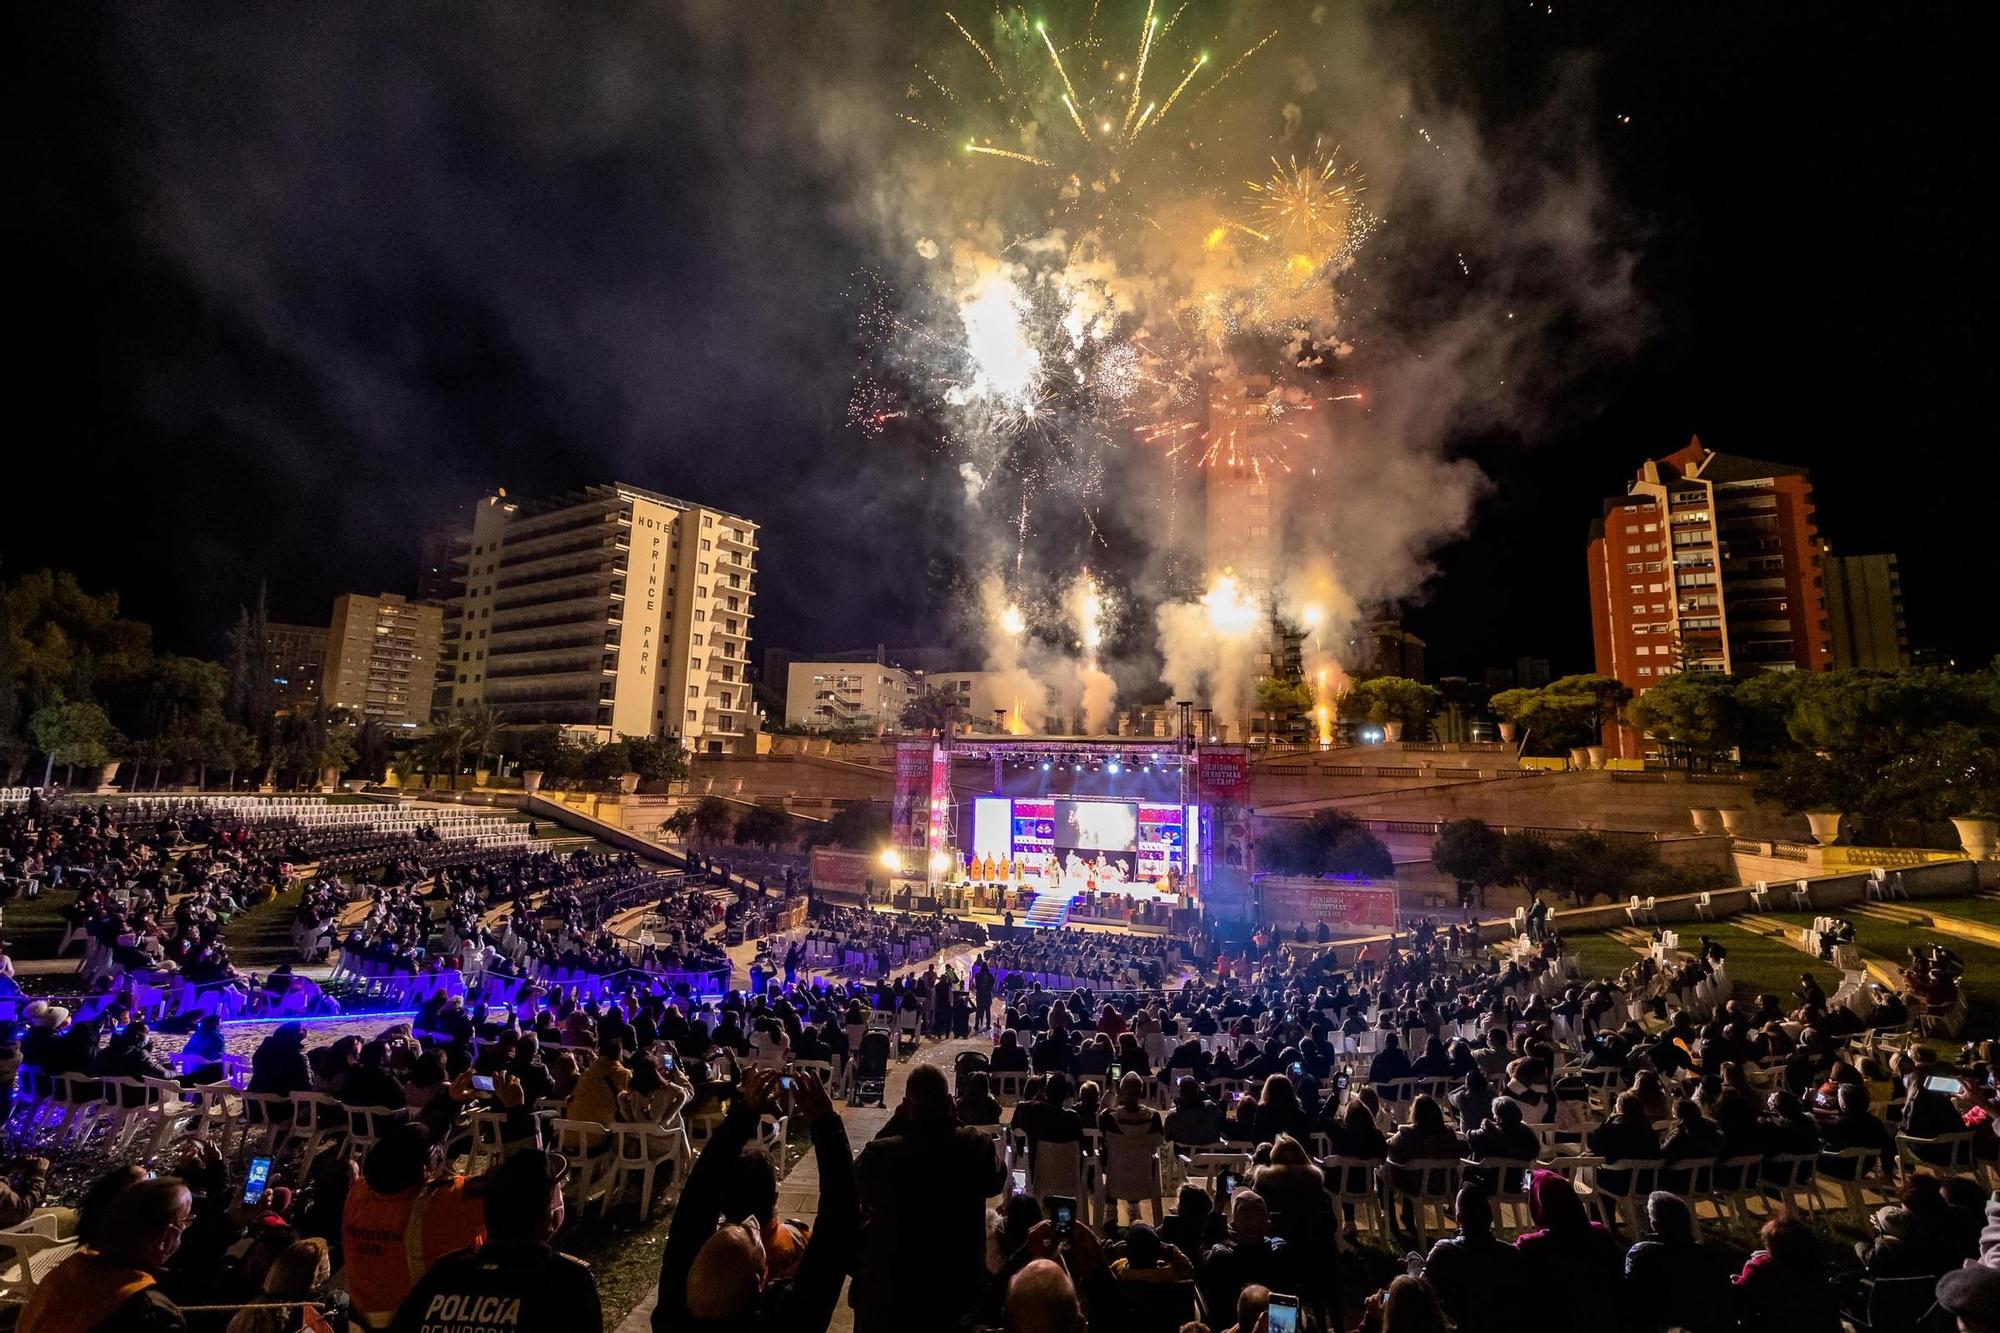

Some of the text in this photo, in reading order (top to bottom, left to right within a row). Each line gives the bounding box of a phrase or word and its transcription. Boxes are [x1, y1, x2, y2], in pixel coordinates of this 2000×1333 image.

[638, 516, 676, 536] HOTEL
[640, 537, 660, 675] PRINCE PARK
[1202, 770, 1241, 779] CHRISTMAS
